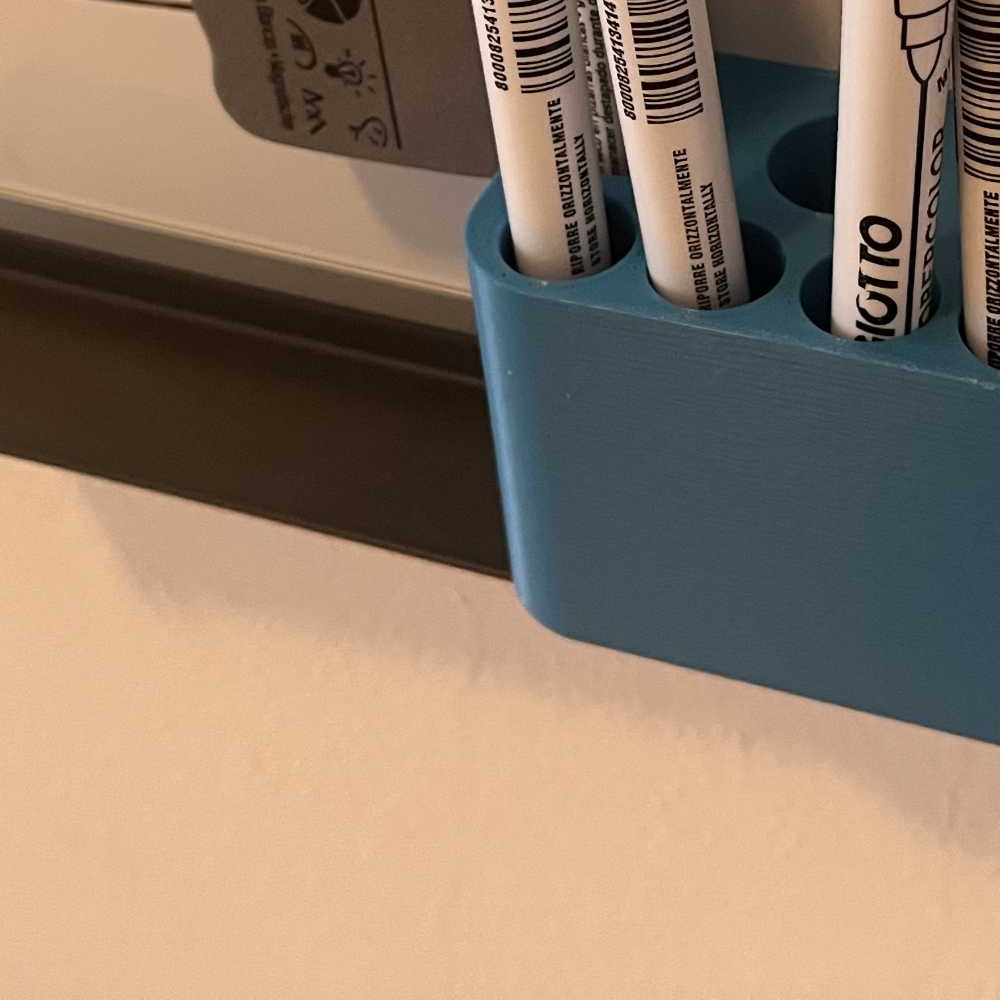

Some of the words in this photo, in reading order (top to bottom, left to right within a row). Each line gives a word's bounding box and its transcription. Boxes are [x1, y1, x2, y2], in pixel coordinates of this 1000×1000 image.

[603, 0, 636, 119] 8000825413414
[546, 97, 576, 217] ORIZZONTALMENTE
[572, 133, 596, 222] HORIZONTALLY
[672, 148, 703, 259] ORIZZONTALMENTE
[700, 181, 724, 266] HORIZONTALLY
[854, 216, 901, 340] IOTTO
[983, 190, 1000, 313] ORIZZONTALMENTE
